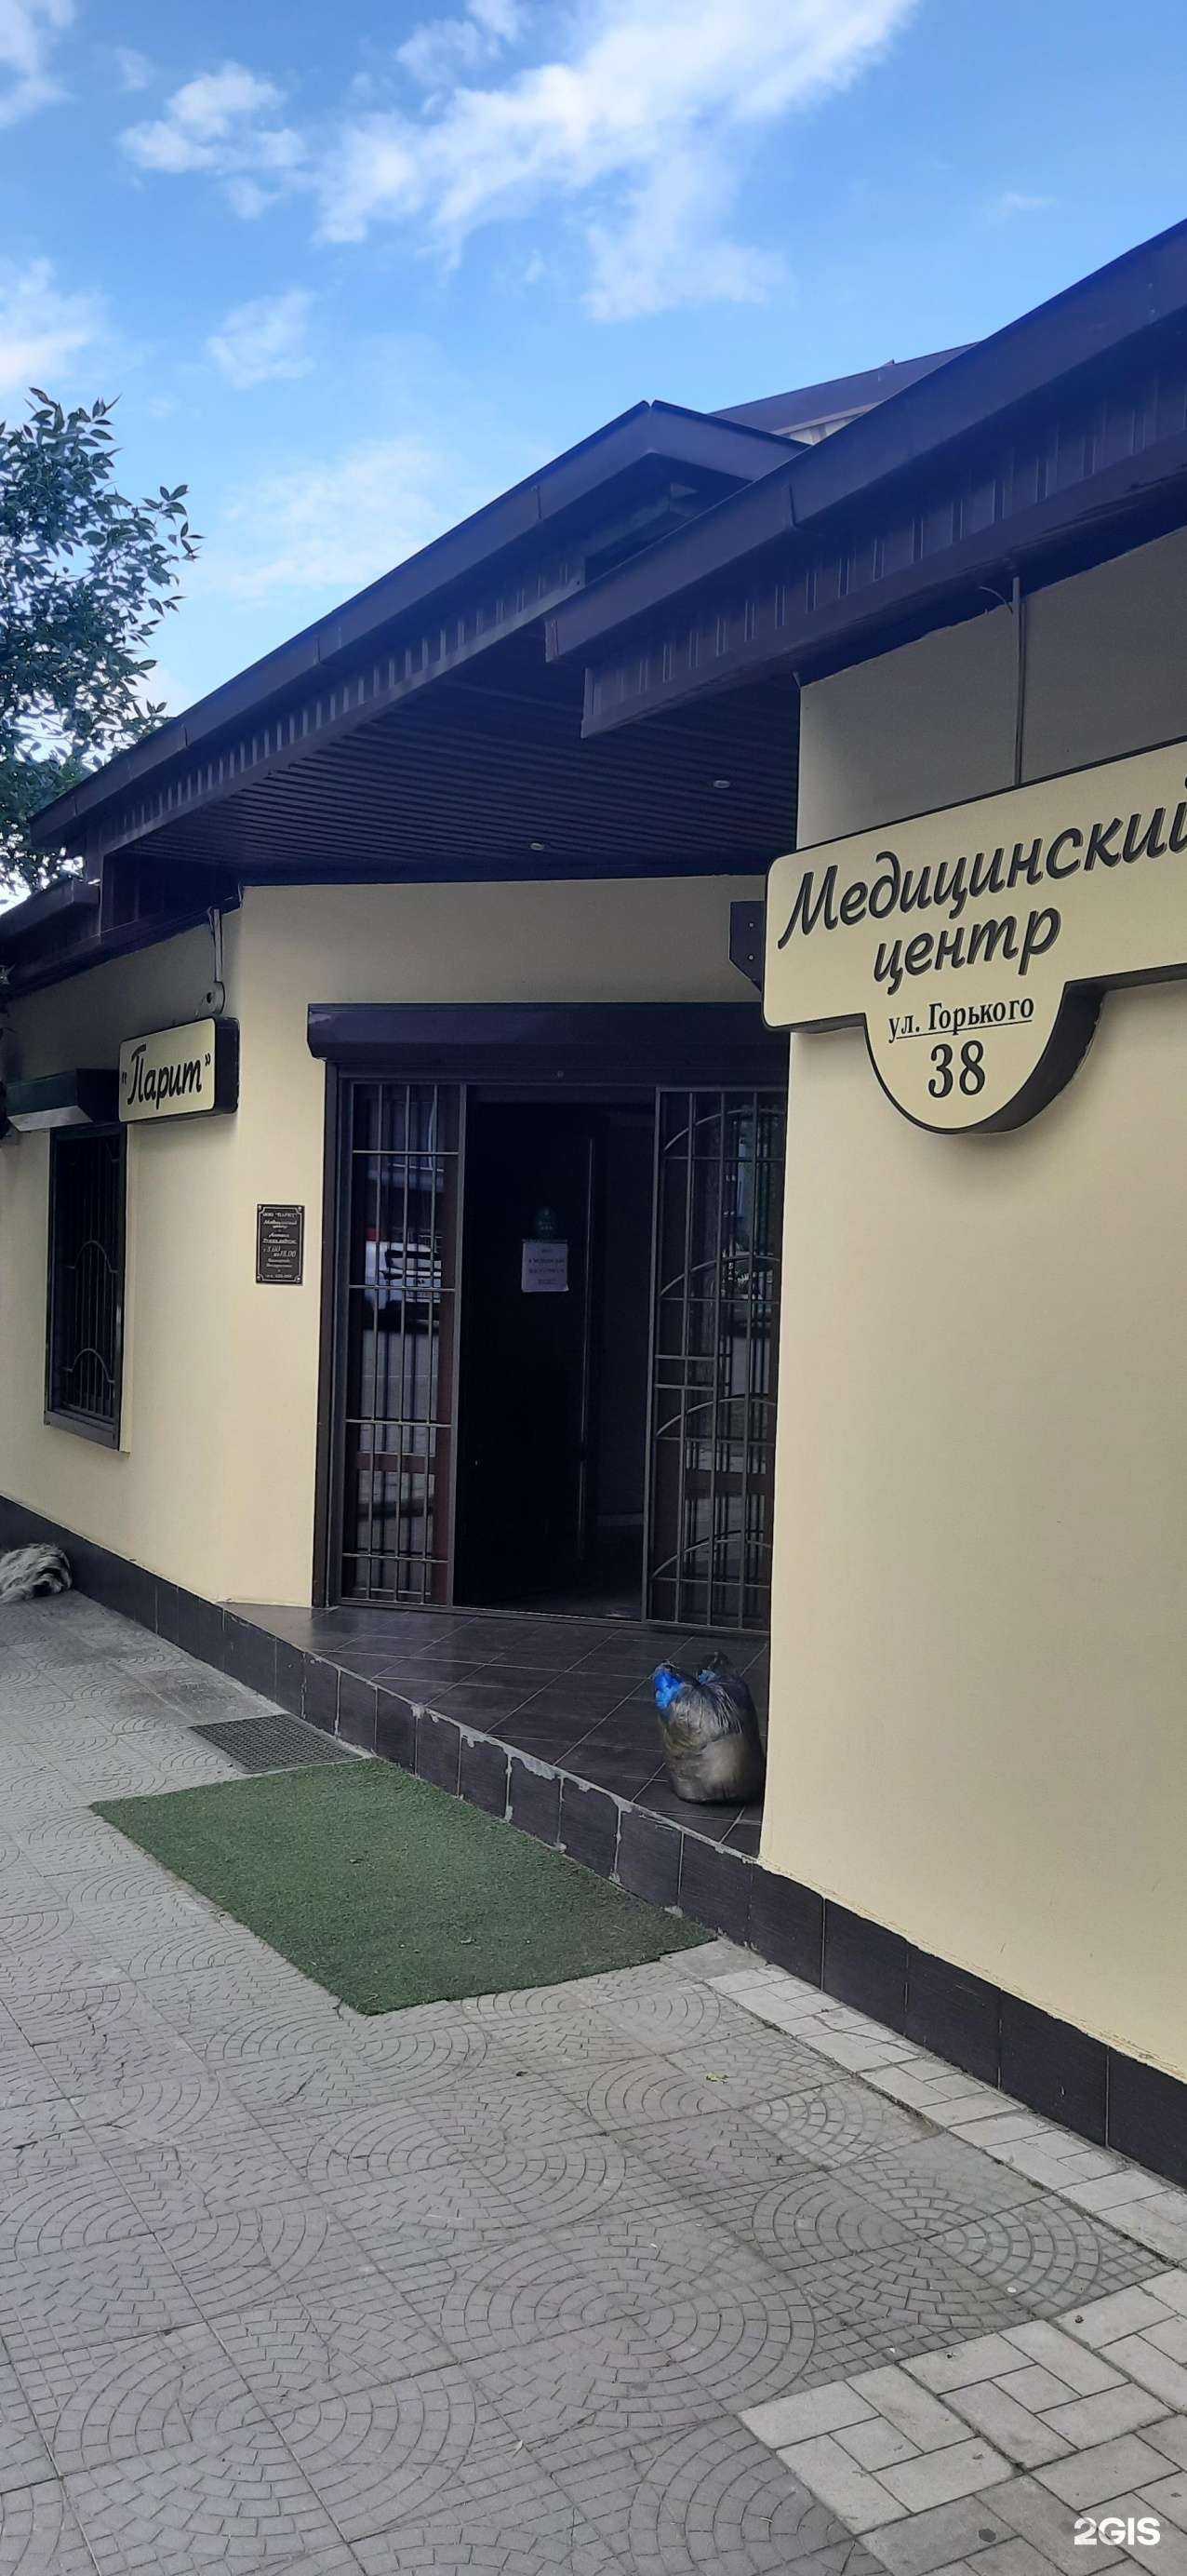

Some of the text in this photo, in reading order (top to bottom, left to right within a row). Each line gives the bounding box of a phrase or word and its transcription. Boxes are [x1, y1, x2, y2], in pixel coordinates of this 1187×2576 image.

[873, 906, 1062, 996] центр
[888, 997, 1034, 1043] ул. Горького
[927, 1040, 986, 1098] 38
